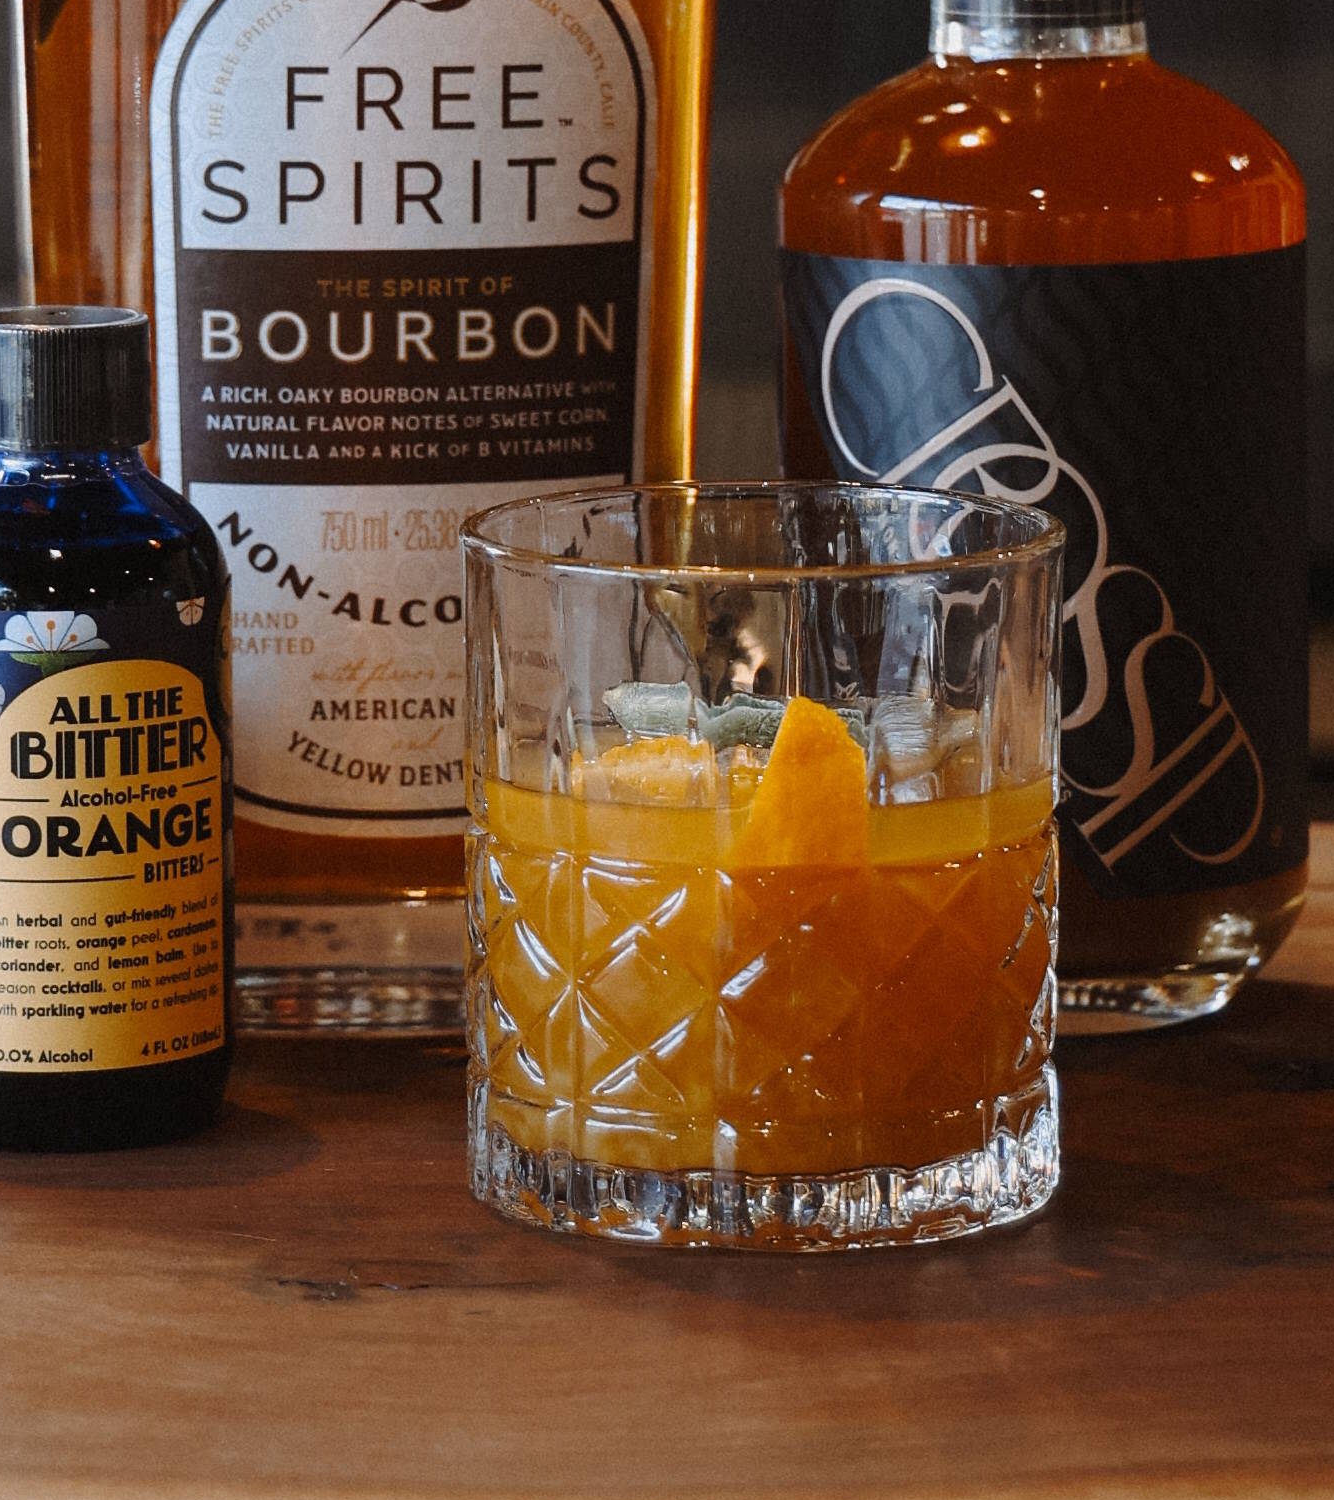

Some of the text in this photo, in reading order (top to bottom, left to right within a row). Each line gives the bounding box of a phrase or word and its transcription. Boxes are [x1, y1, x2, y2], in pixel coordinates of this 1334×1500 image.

[235, 1, 293, 52] SPIRITS
[285, 63, 545, 132] FREE
[199, 153, 622, 227] SPIRITS
[316, 275, 514, 299] THE SPIRIT OF
[200, 302, 617, 364] BOURBON
[201, 385, 216, 403] A
[278, 386, 335, 404] OAKY
[340, 385, 439, 404] BOURBON
[445, 381, 574, 402] ALTERNATIVE
[206, 413, 301, 432] NATURAL
[307, 415, 386, 433] FLAVOR
[391, 414, 459, 432] NOTES
[463, 415, 483, 429] OF
[490, 410, 554, 430] SWEET
[226, 435, 596, 461] VANILLA AND A KICK OF B VITAMINS
[322, 509, 358, 552] 750
[363, 509, 389, 552] ml
[217, 510, 464, 628] NON-ALCO
[233, 611, 300, 631] HAND
[230, 636, 316, 656] RAFTED
[48, 685, 184, 726] ALL THE
[309, 697, 457, 722] AMERICAN
[9, 715, 208, 781] BITTER
[286, 730, 393, 786] YELLOW
[60, 783, 178, 808] Alcohol-Free
[0, 797, 214, 859] ORANGE
[143, 853, 206, 884] BITTERS
[16, 913, 63, 928] herbal
[70, 912, 97, 927] and
[104, 903, 177, 929] gut-friendly
[76, 935, 127, 951] orange
[73, 956, 100, 972] and
[107, 955, 149, 971] lemon
[112, 980, 127, 992] or
[131, 975, 152, 990] mix
[154, 966, 192, 987] several
[22, 1003, 86, 1021] sparkling
[88, 1001, 128, 1016] water
[130, 997, 148, 1013] for
[151, 998, 160, 1010] a
[38, 1047, 94, 1064] Alcohol
[140, 1042, 150, 1057] 4
[153, 1039, 169, 1056] FL
[171, 1034, 190, 1052] OZ
